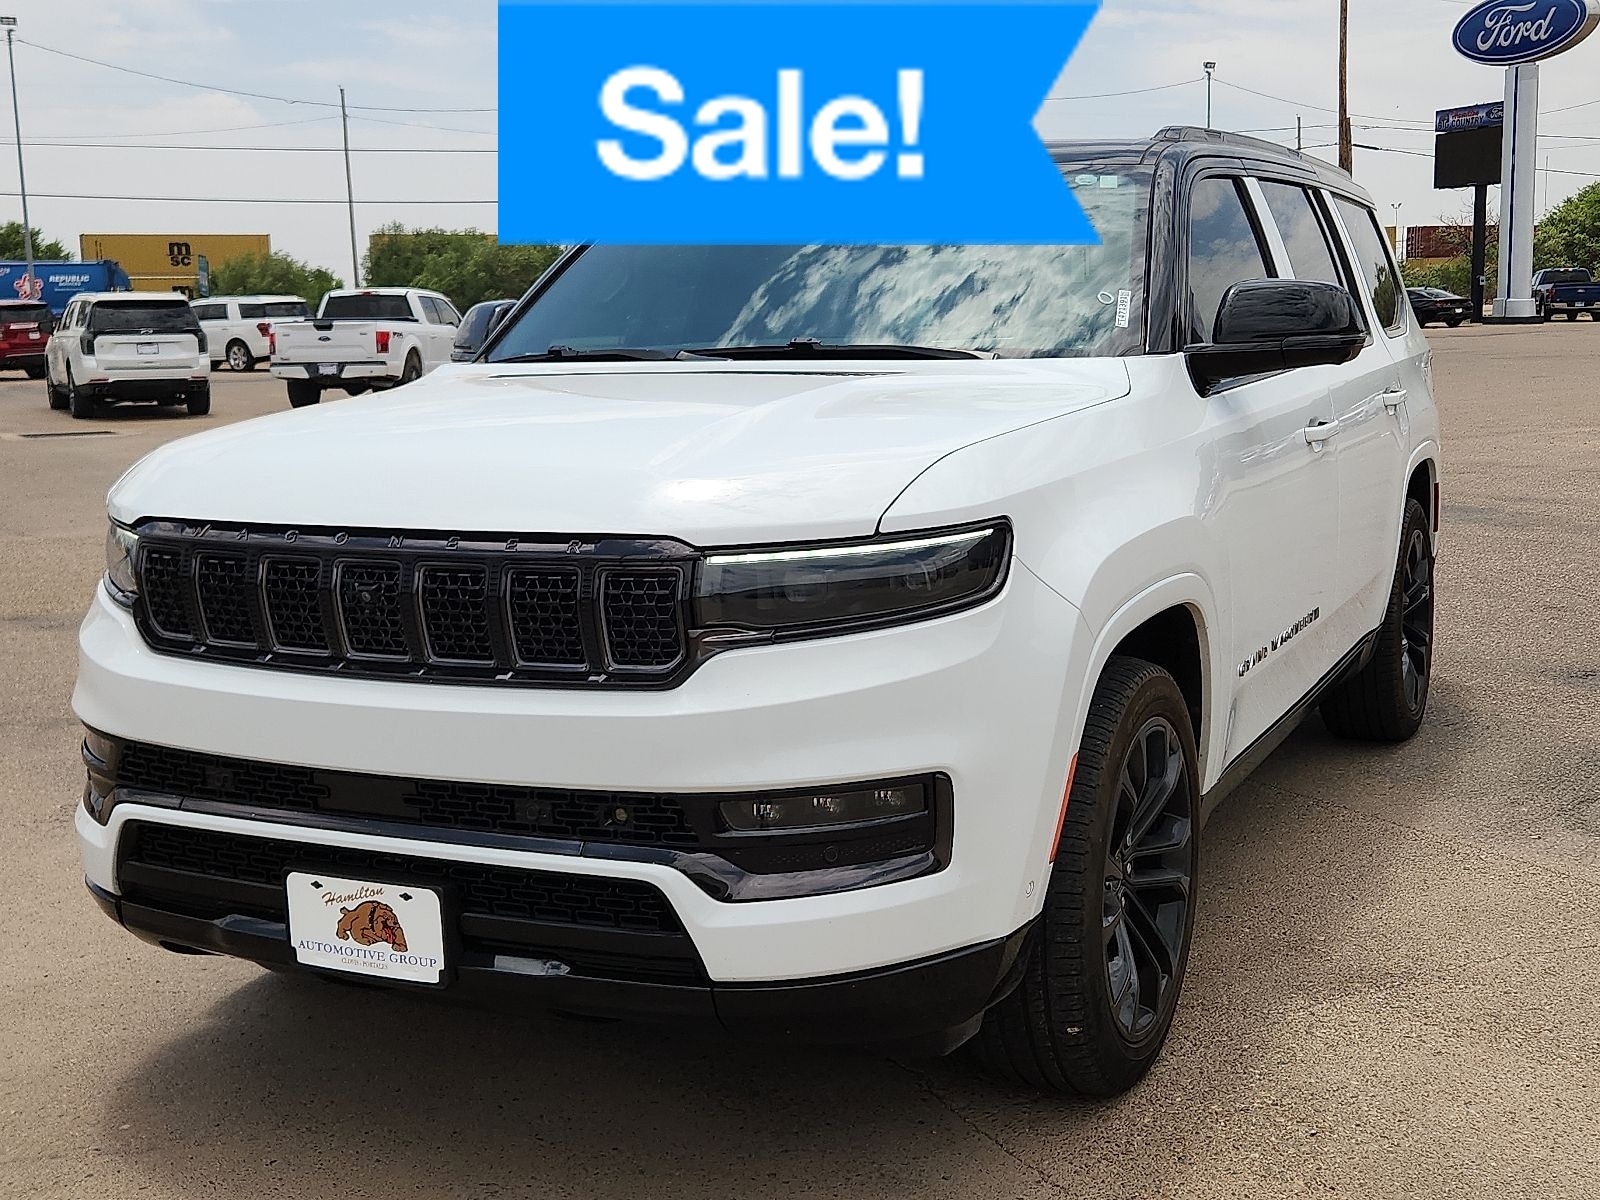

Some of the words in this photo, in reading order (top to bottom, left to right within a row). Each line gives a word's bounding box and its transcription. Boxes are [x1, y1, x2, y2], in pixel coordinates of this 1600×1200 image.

[1476, 1, 1556, 51] Ford
[1451, 115, 1484, 128] COUNTRY
[48, 275, 90, 283] REPUBLIC
[192, 523, 583, 554] WAGONEER
[321, 886, 385, 907] Hamilton
[298, 940, 386, 961] AUTOMOTIVE
[389, 951, 437, 968] GROUP
